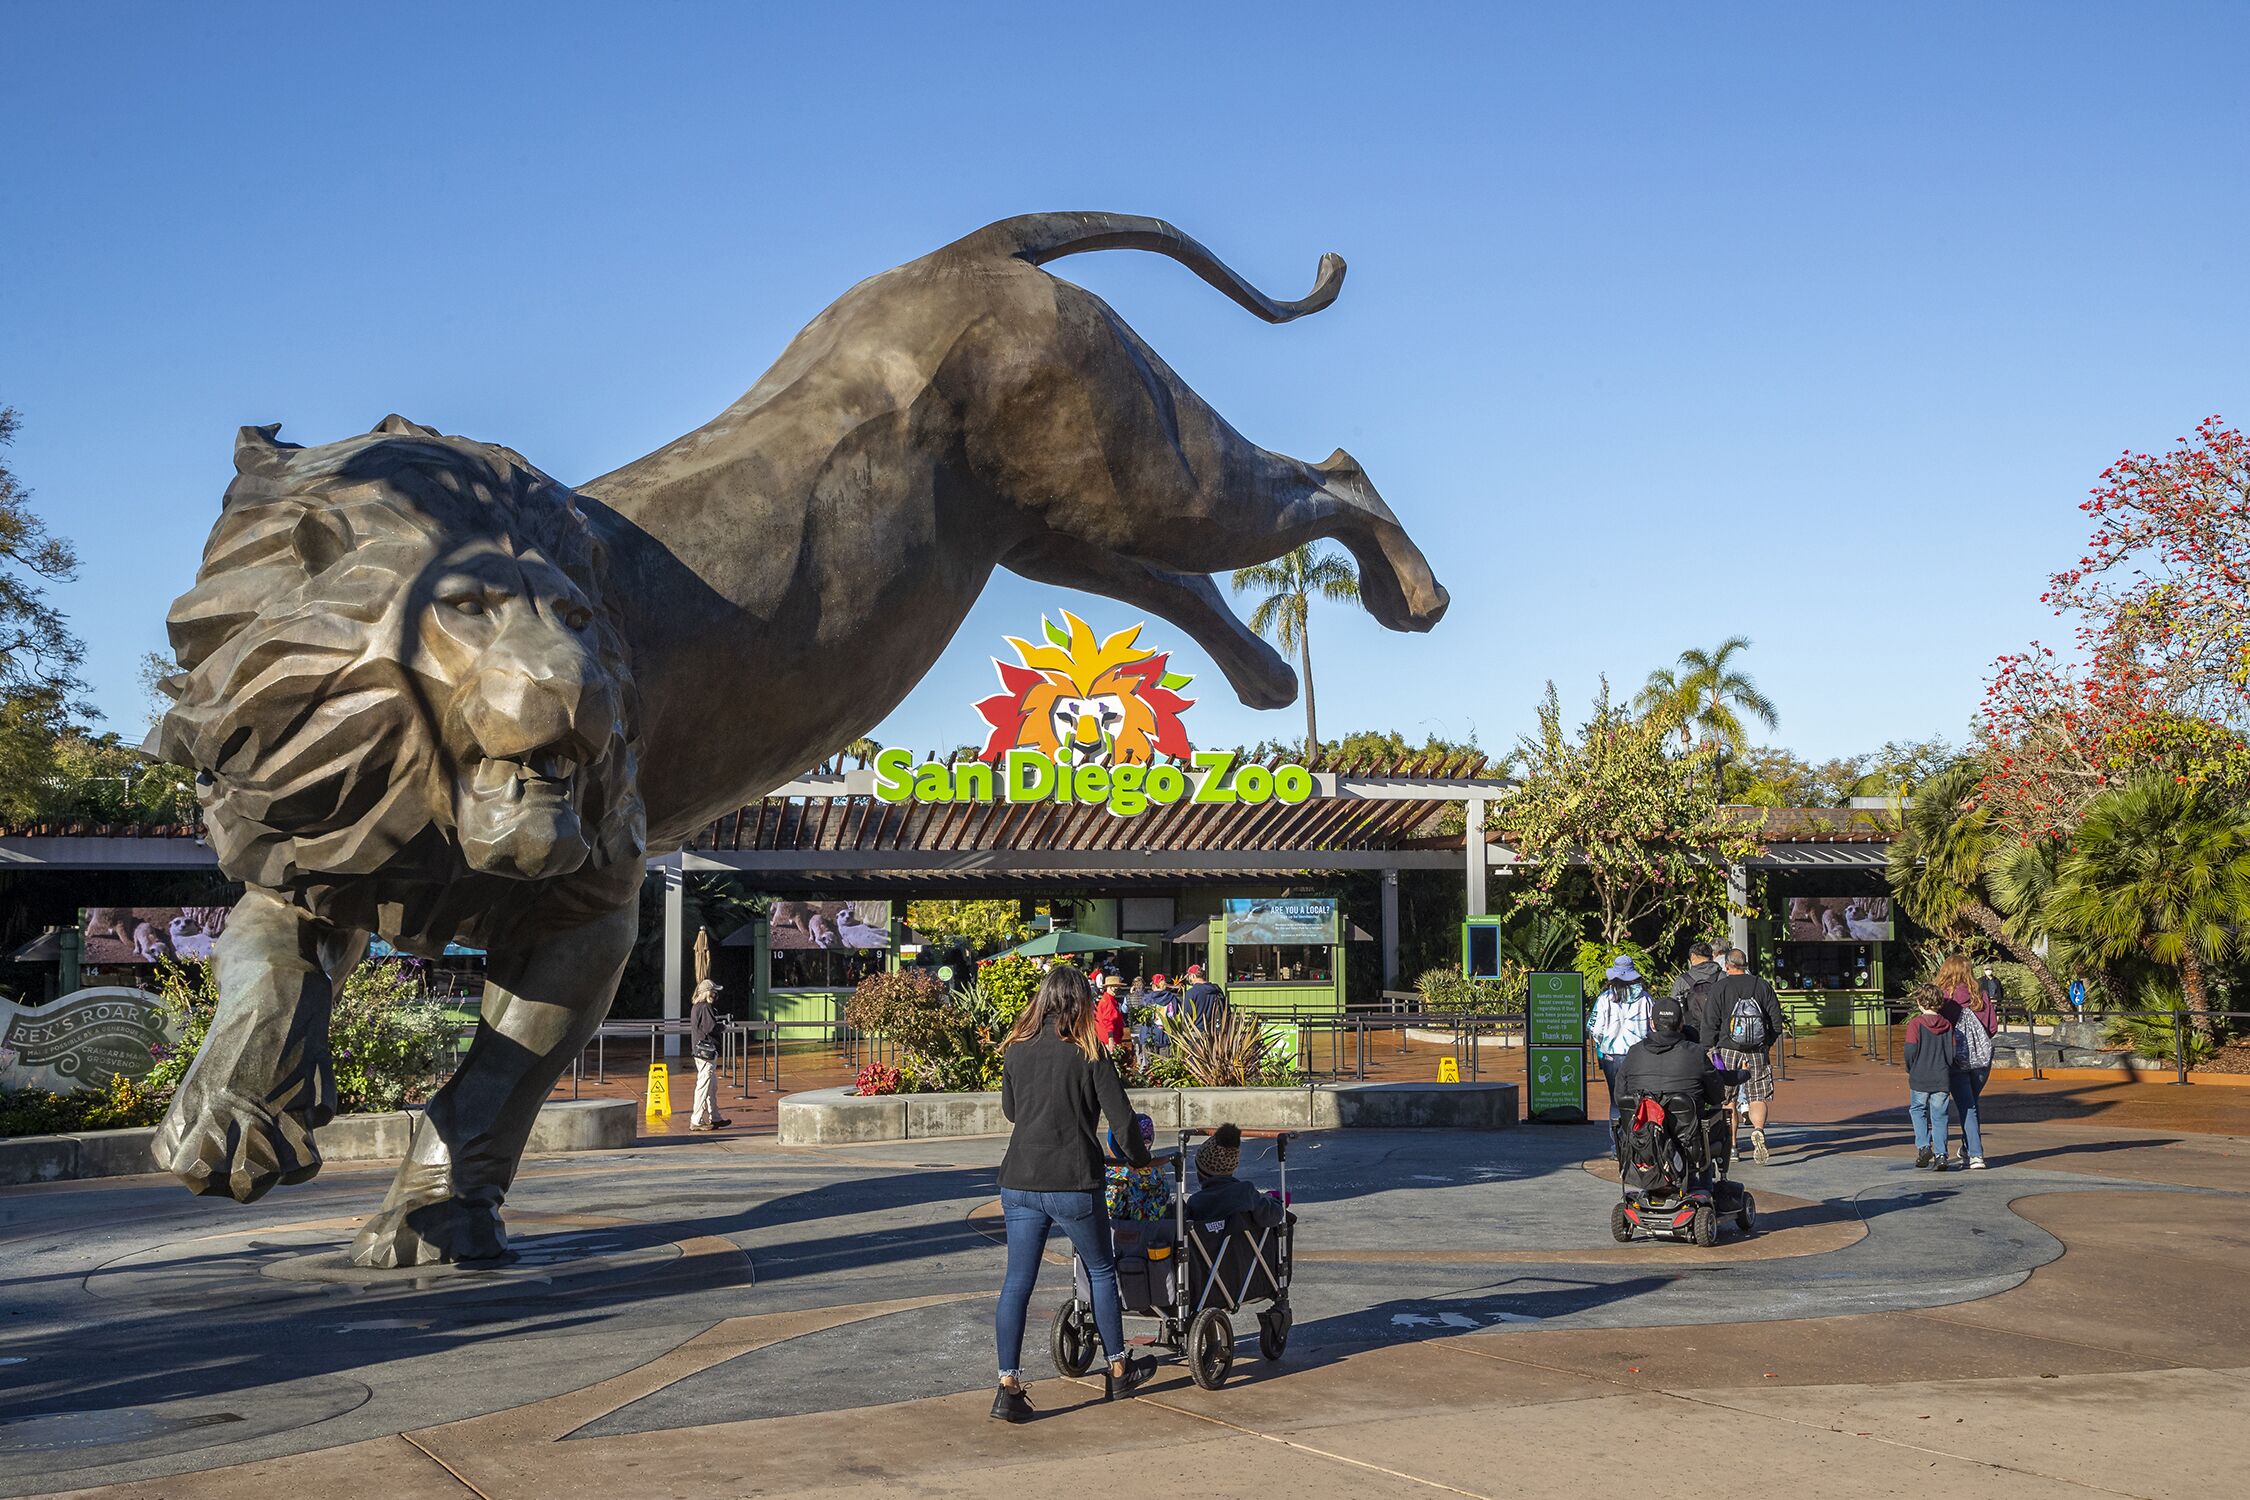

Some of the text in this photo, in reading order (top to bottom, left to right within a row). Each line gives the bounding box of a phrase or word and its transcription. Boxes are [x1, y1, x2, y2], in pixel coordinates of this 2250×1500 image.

[873, 747, 1312, 818] San Diego Zoo
[1270, 906, 1330, 914] ARE YOU A LOCAL?
[1228, 946, 1234, 954] 8
[1322, 945, 1328, 954] 7
[1776, 947, 1782, 955] 6
[1860, 946, 1865, 954] 5
[773, 950, 784, 959] 10
[876, 950, 883, 959] 9
[86, 966, 99, 977] 14
[13, 1006, 140, 1043] REX'S ROAR
[50, 1037, 82, 1053] POSSIBLE
[102, 1025, 139, 1037] GENEROUS
[87, 1055, 142, 1070] GROSVENOR
